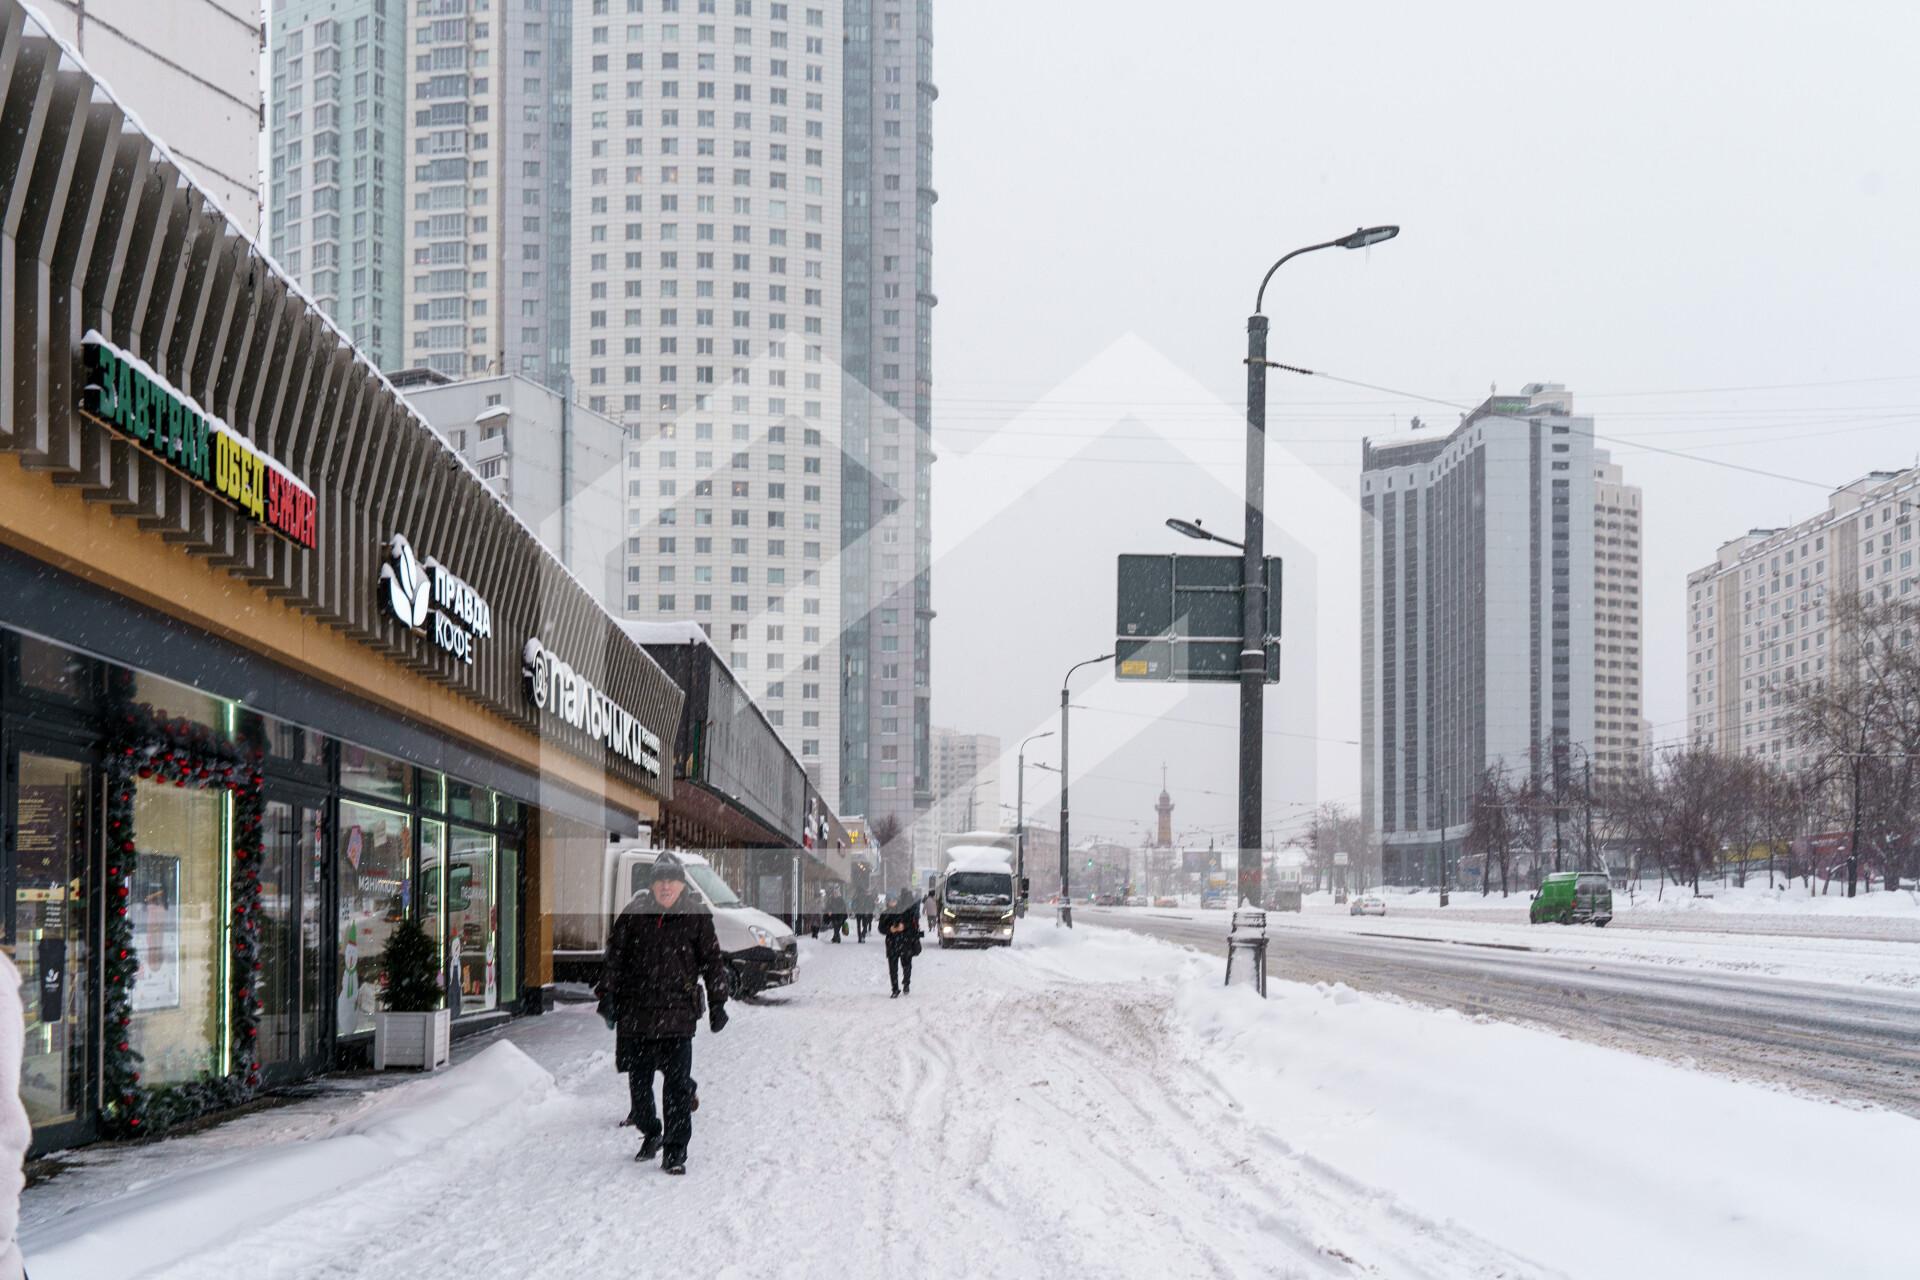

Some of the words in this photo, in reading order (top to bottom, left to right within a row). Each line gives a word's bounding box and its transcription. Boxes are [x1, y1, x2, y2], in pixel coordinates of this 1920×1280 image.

[100, 344, 211, 482] ЗАВТРАК
[216, 431, 265, 523] ОБЕД
[268, 466, 317, 550] УЖИН
[435, 566, 492, 639] ПРАВДА
[435, 611, 473, 665] КОФЕ
[549, 658, 642, 766] пальчики
